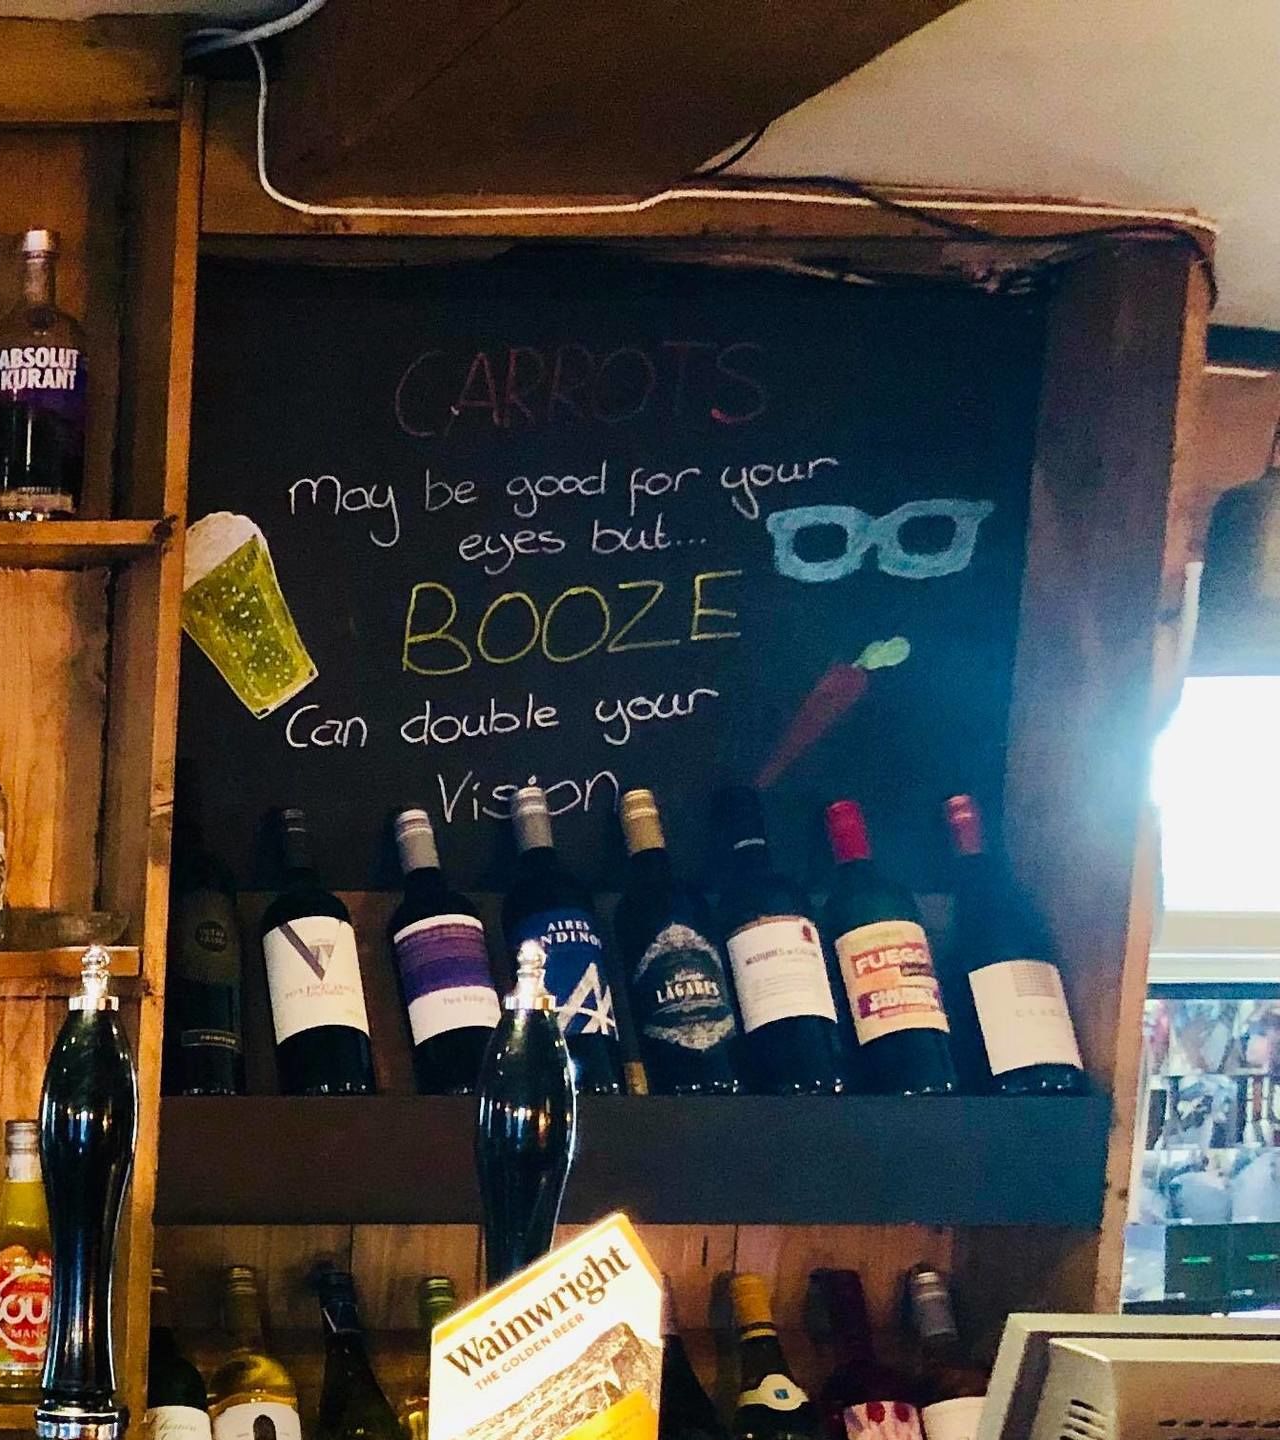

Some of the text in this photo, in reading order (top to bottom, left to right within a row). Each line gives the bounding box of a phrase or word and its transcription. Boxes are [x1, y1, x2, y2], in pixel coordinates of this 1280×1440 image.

[0, 369, 76, 391] KURANT
[393, 341, 770, 438] CARROTS
[424, 468, 478, 510] be
[506, 460, 608, 517] good
[629, 465, 701, 517] for
[719, 456, 839, 521] your
[458, 524, 566, 576] eyes
[402, 570, 744, 676] BOOZE
[285, 687, 719, 749] Can double your
[546, 919, 590, 932] AIRES
[443, 1246, 632, 1378] Wainwright
[474, 1312, 586, 1391] THE GOLDEN BEER
